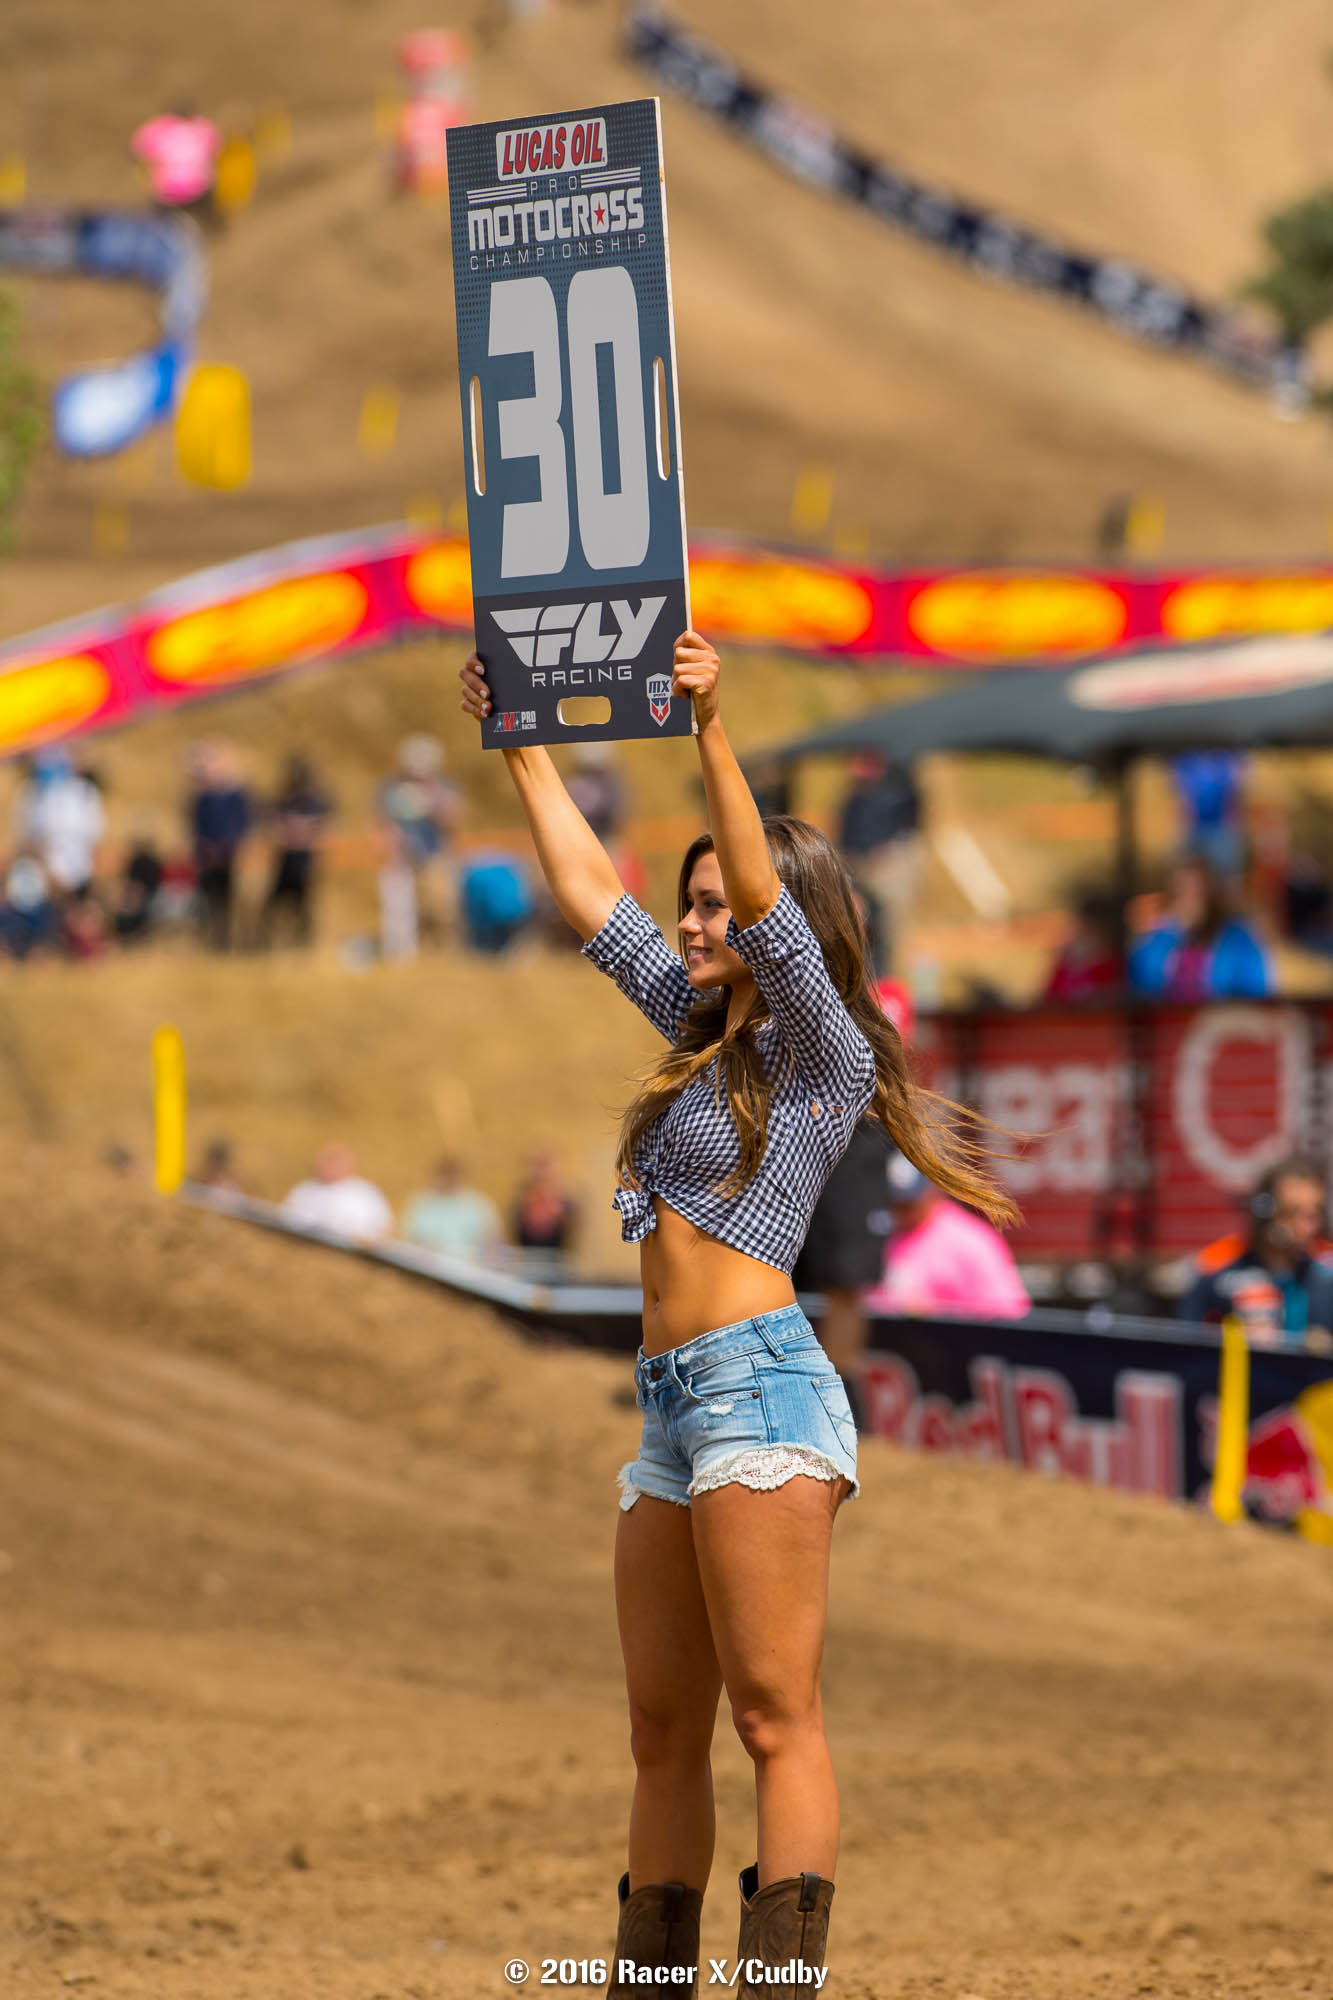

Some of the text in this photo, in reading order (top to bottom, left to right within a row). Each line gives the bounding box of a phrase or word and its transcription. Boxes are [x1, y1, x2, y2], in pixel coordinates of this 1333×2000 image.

[502, 122, 603, 176] LUCAS OIL
[530, 176, 577, 195] PRO
[467, 187, 645, 251] MOTOCROSS
[470, 234, 647, 271] CHAMPIONSHIP
[488, 266, 650, 579] 30
[490, 596, 668, 668] FLY
[531, 665, 632, 688] RACING
[649, 680, 670, 693] MX
[521, 711, 536, 723] PRO
